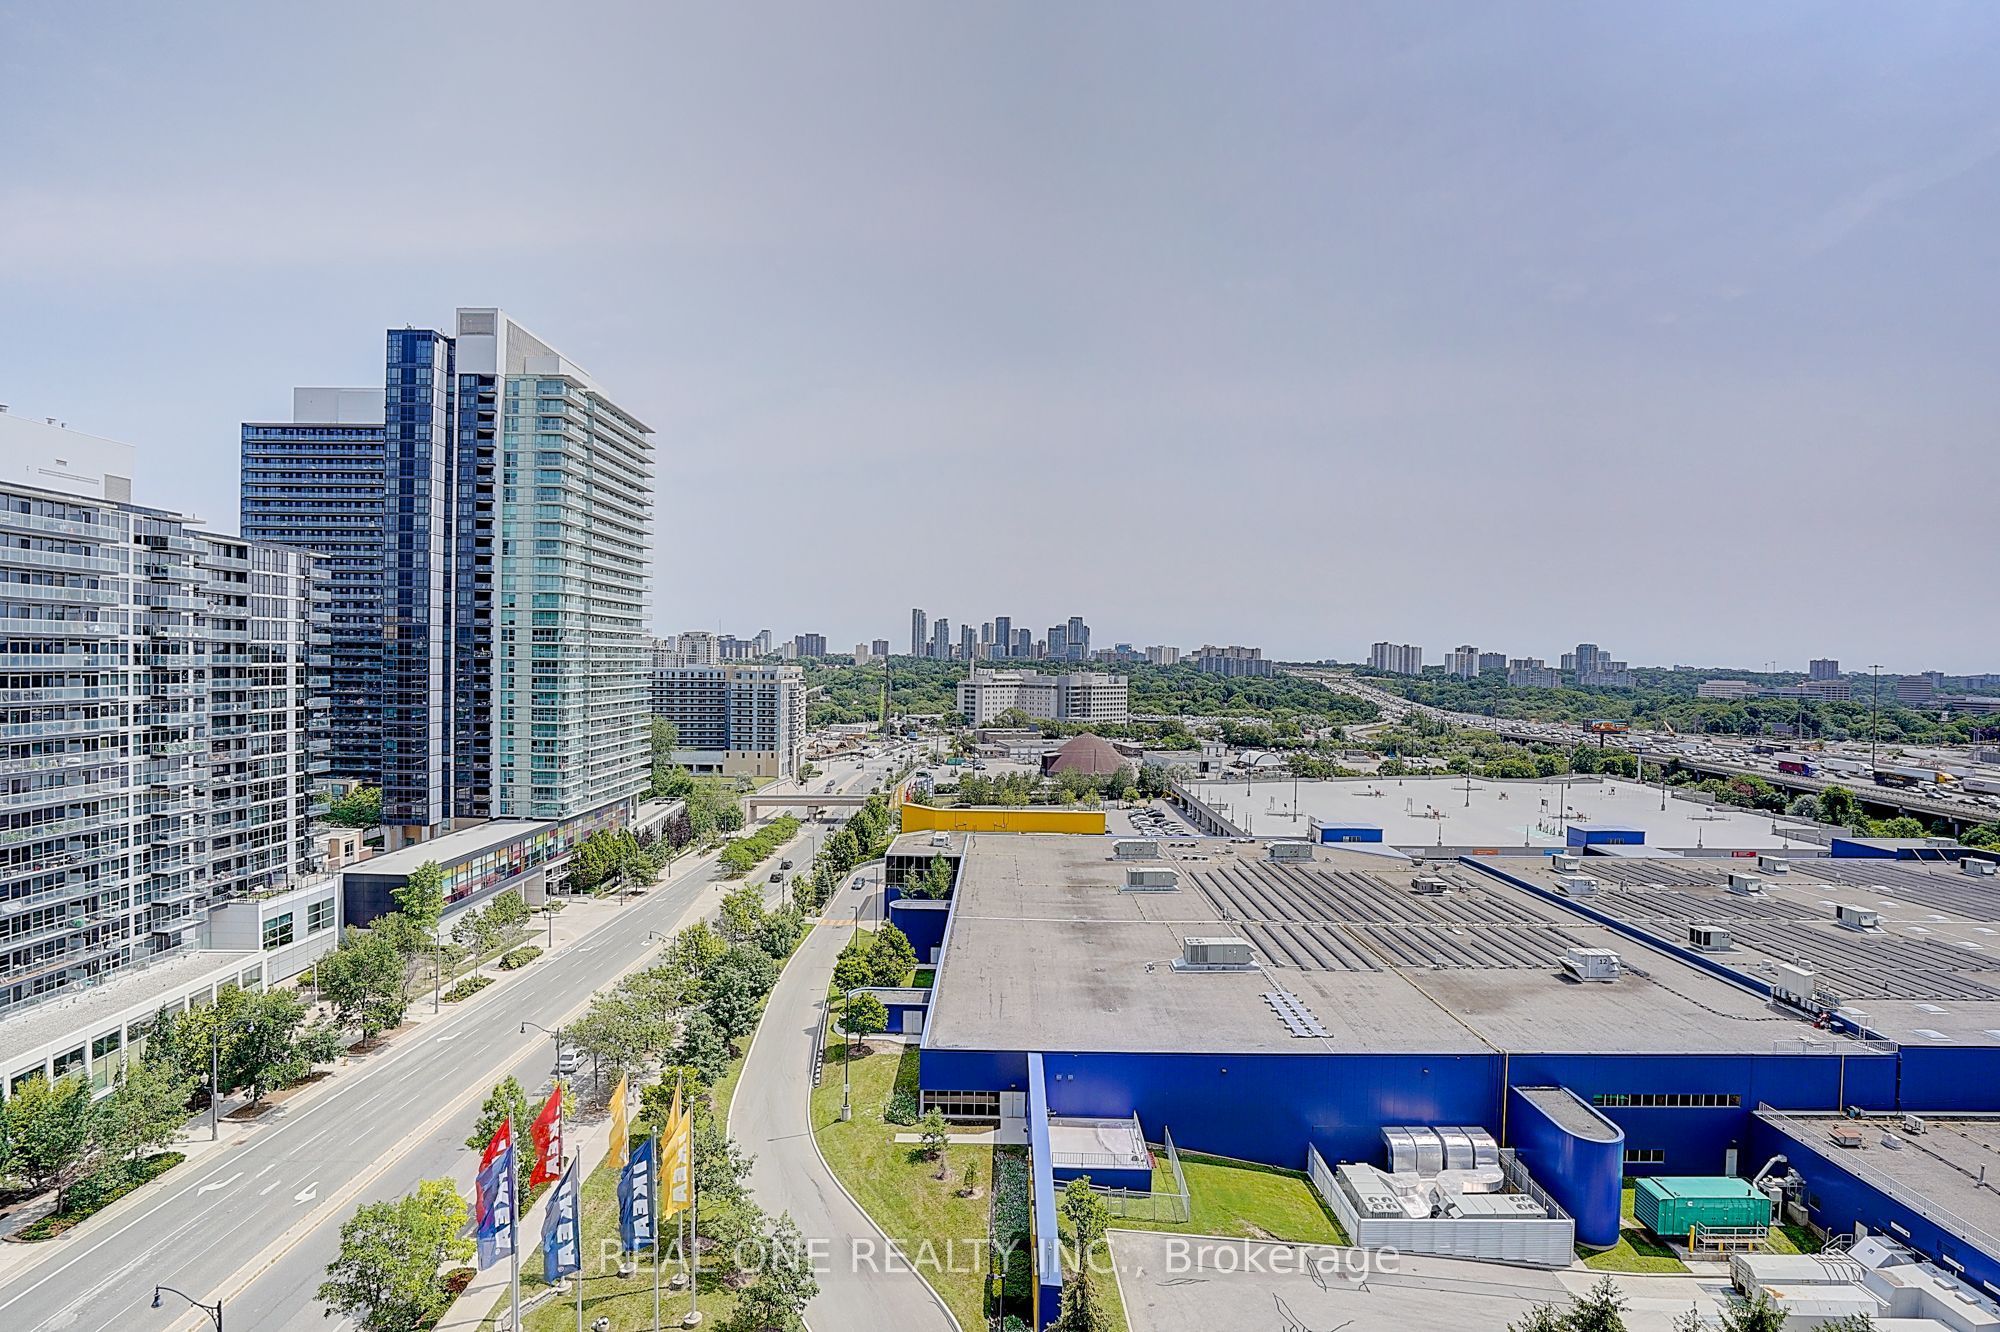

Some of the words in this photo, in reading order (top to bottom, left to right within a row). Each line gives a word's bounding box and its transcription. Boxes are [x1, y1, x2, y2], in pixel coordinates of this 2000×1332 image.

[632, 1160, 650, 1238] IKEA
[672, 1131, 688, 1202] IKEA
[494, 1167, 511, 1249] IKEA
[557, 1181, 576, 1266] IKEA
